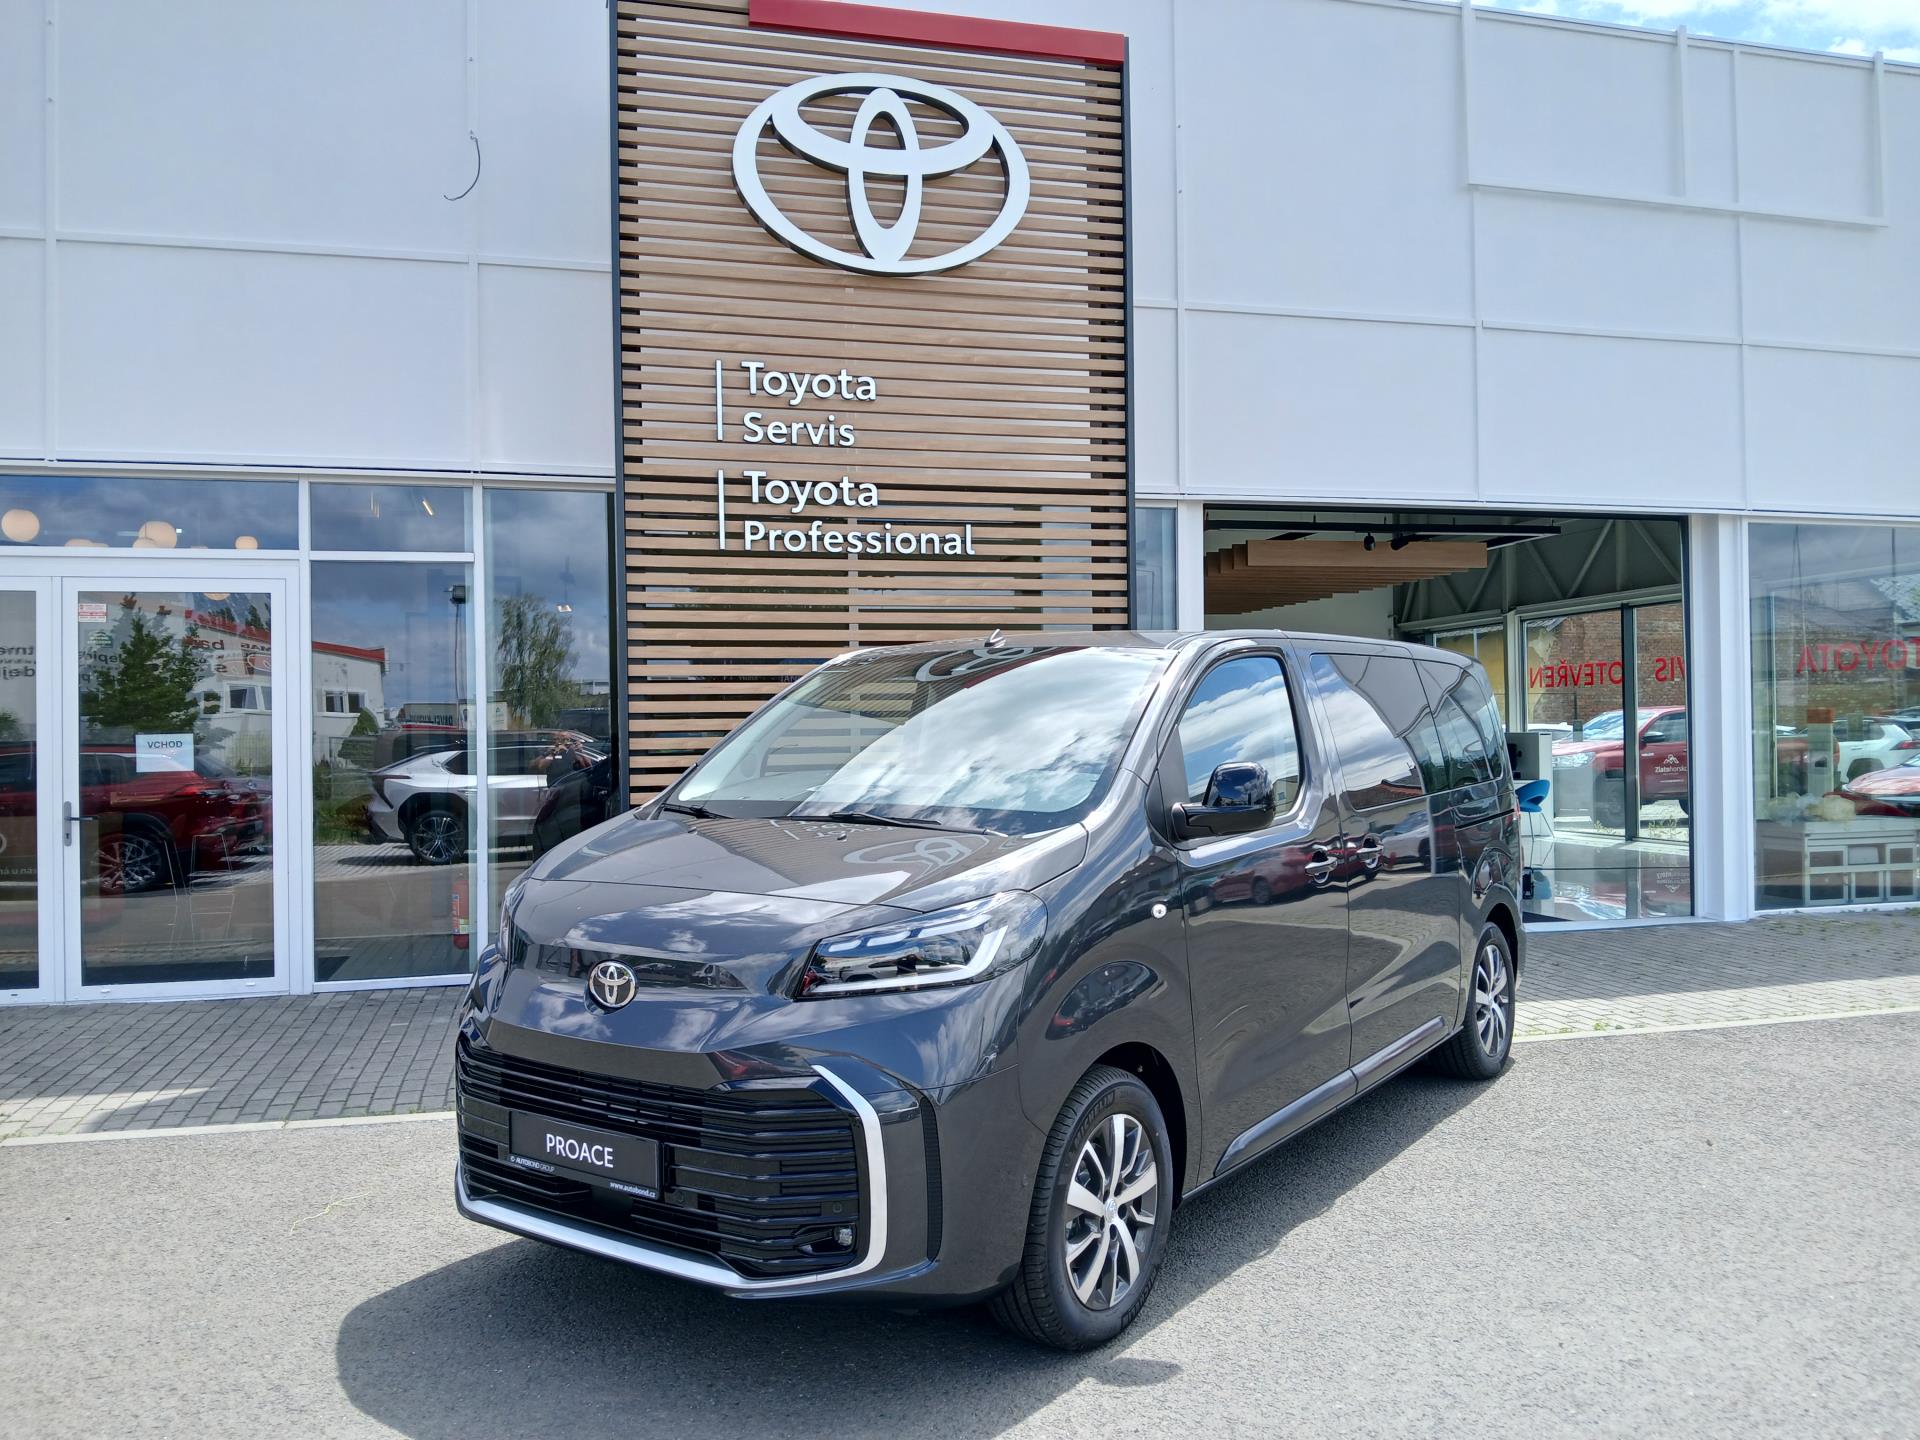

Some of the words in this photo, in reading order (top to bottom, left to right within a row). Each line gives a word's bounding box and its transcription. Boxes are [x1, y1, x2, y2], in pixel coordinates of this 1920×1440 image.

[741, 361, 877, 406] Toyota
[743, 411, 855, 446] Servis
[743, 470, 878, 513] Toyota
[744, 520, 975, 555] Professional
[147, 740, 183, 749] VCHOD
[546, 1133, 614, 1168] PROACE
